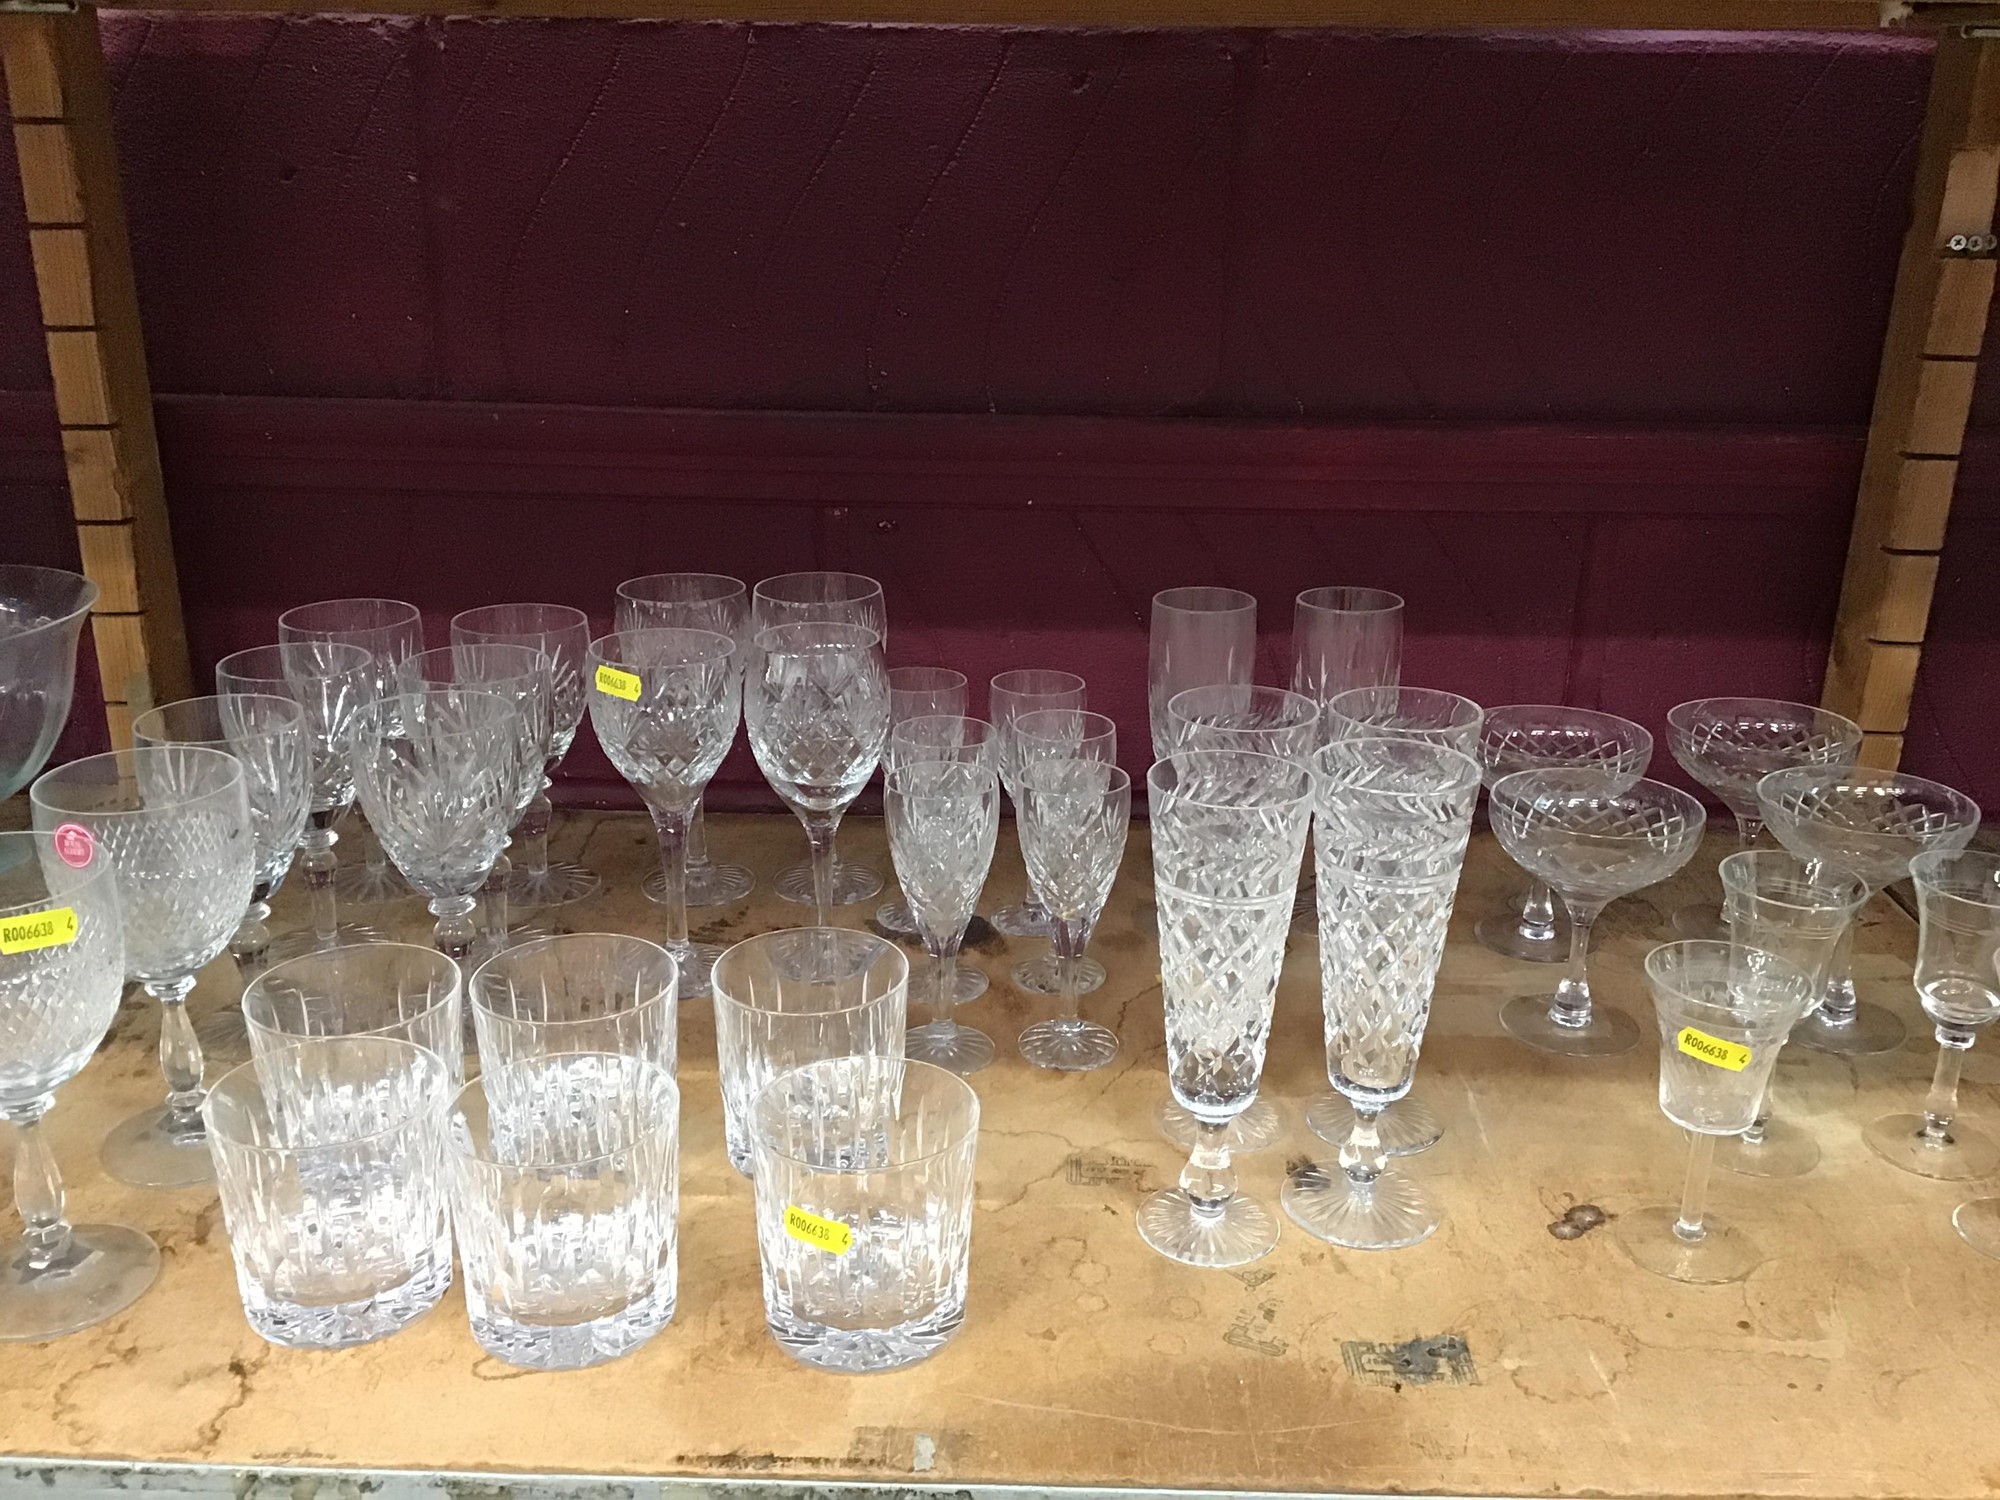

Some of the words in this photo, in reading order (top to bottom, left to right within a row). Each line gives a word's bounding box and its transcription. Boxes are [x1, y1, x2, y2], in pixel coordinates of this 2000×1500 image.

[3, 921, 54, 943] R006638
[66, 916, 73, 931] 4
[1684, 1033, 1729, 1060] R006638
[1738, 1053, 1747, 1064] 4
[790, 1213, 830, 1240] R006638
[841, 1232, 849, 1246] 4
